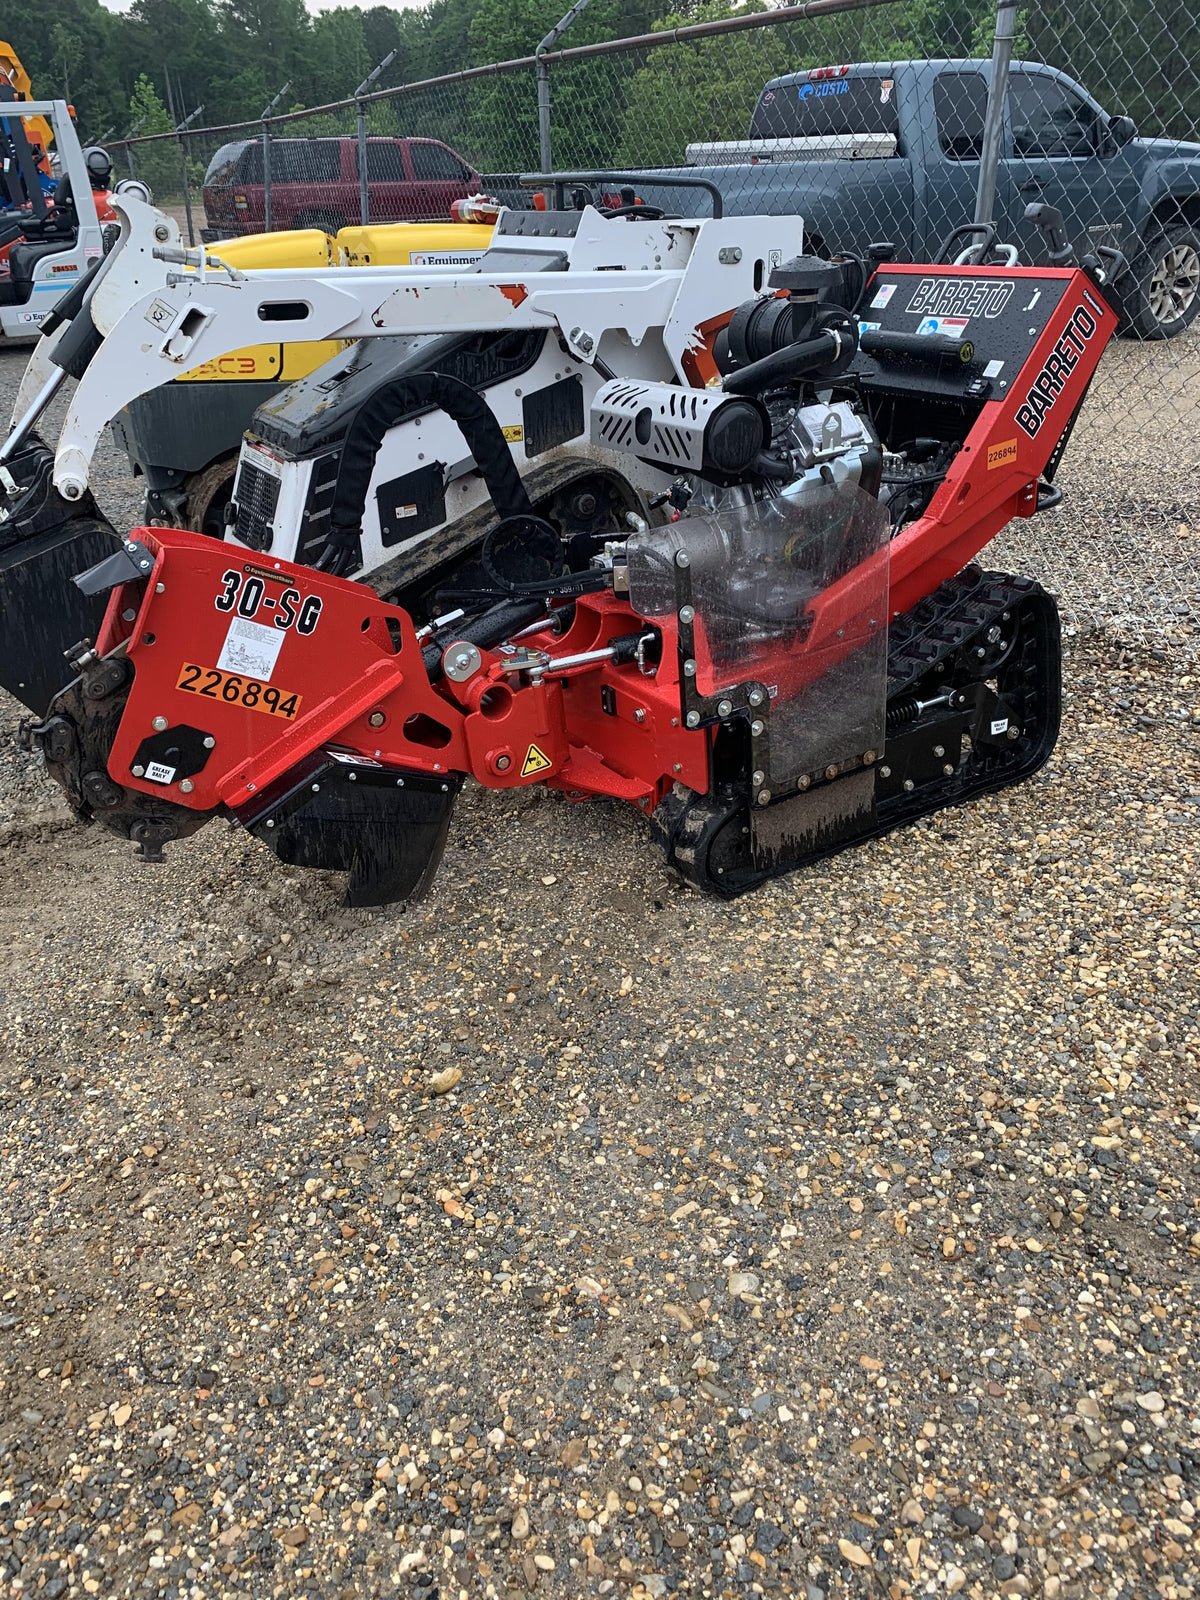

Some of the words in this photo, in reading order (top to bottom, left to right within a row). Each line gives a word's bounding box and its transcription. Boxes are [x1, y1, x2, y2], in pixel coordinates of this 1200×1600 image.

[815, 81, 849, 97] COSTA
[905, 279, 1015, 318] BARRETO
[1014, 305, 1096, 440] BARRETO
[989, 445, 1016, 463] 226894
[215, 569, 323, 636] 30-SG
[178, 665, 298, 718] 226894
